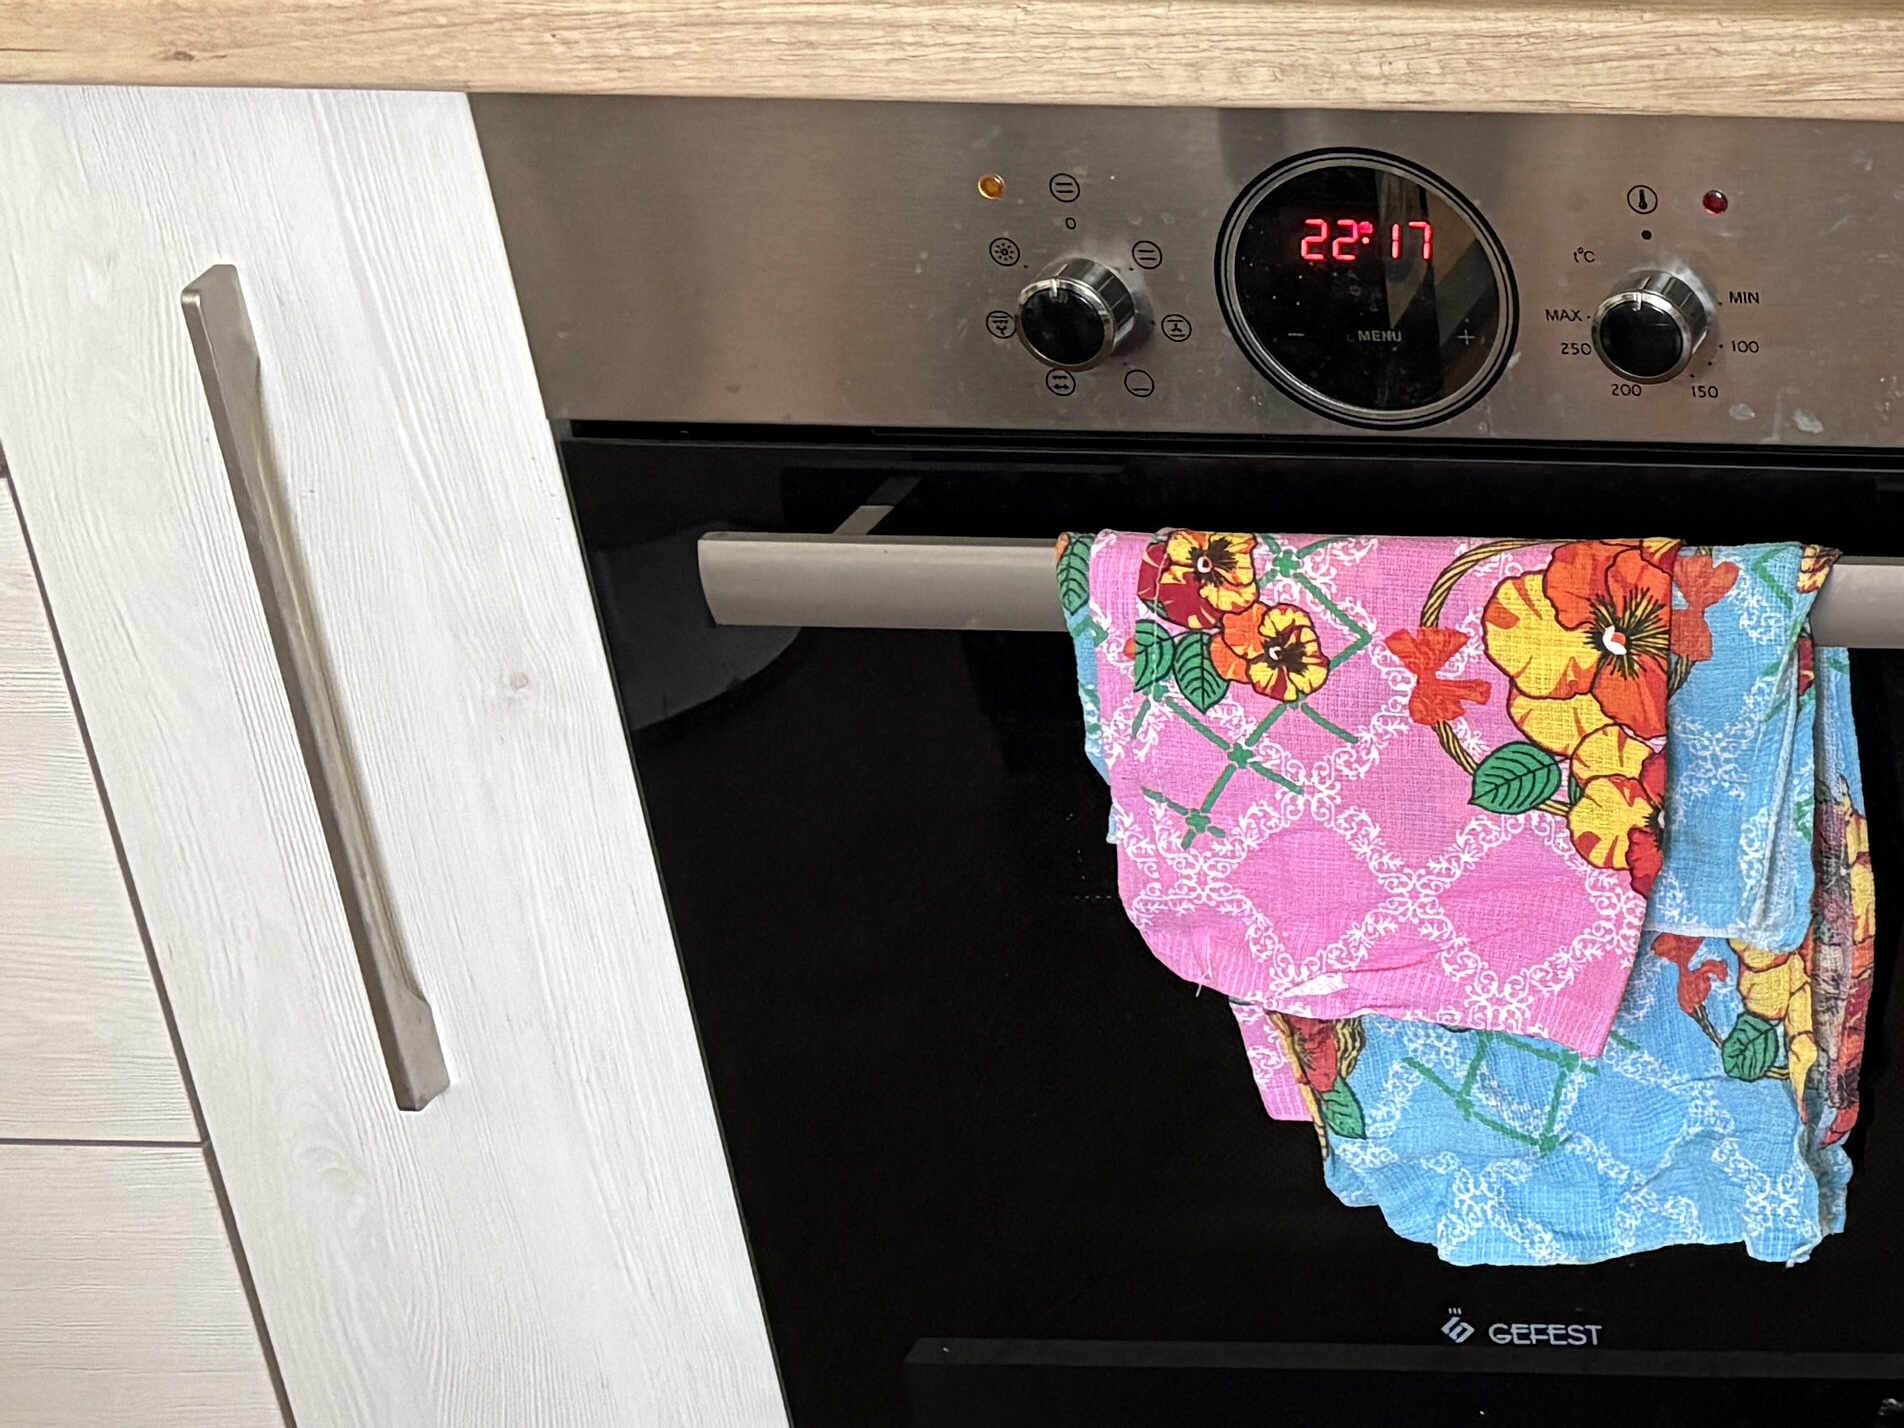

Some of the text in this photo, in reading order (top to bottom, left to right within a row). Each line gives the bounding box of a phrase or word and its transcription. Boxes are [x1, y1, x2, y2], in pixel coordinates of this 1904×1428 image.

[1729, 290, 1760, 305] MIN
[1545, 308, 1582, 322] MAX
[1357, 329, 1403, 342] MENU
[1560, 342, 1593, 356] 250
[1731, 340, 1760, 354] 100
[1611, 383, 1643, 397] 200
[1691, 385, 1719, 399] 150
[1488, 1323, 1602, 1345] GEFEST
